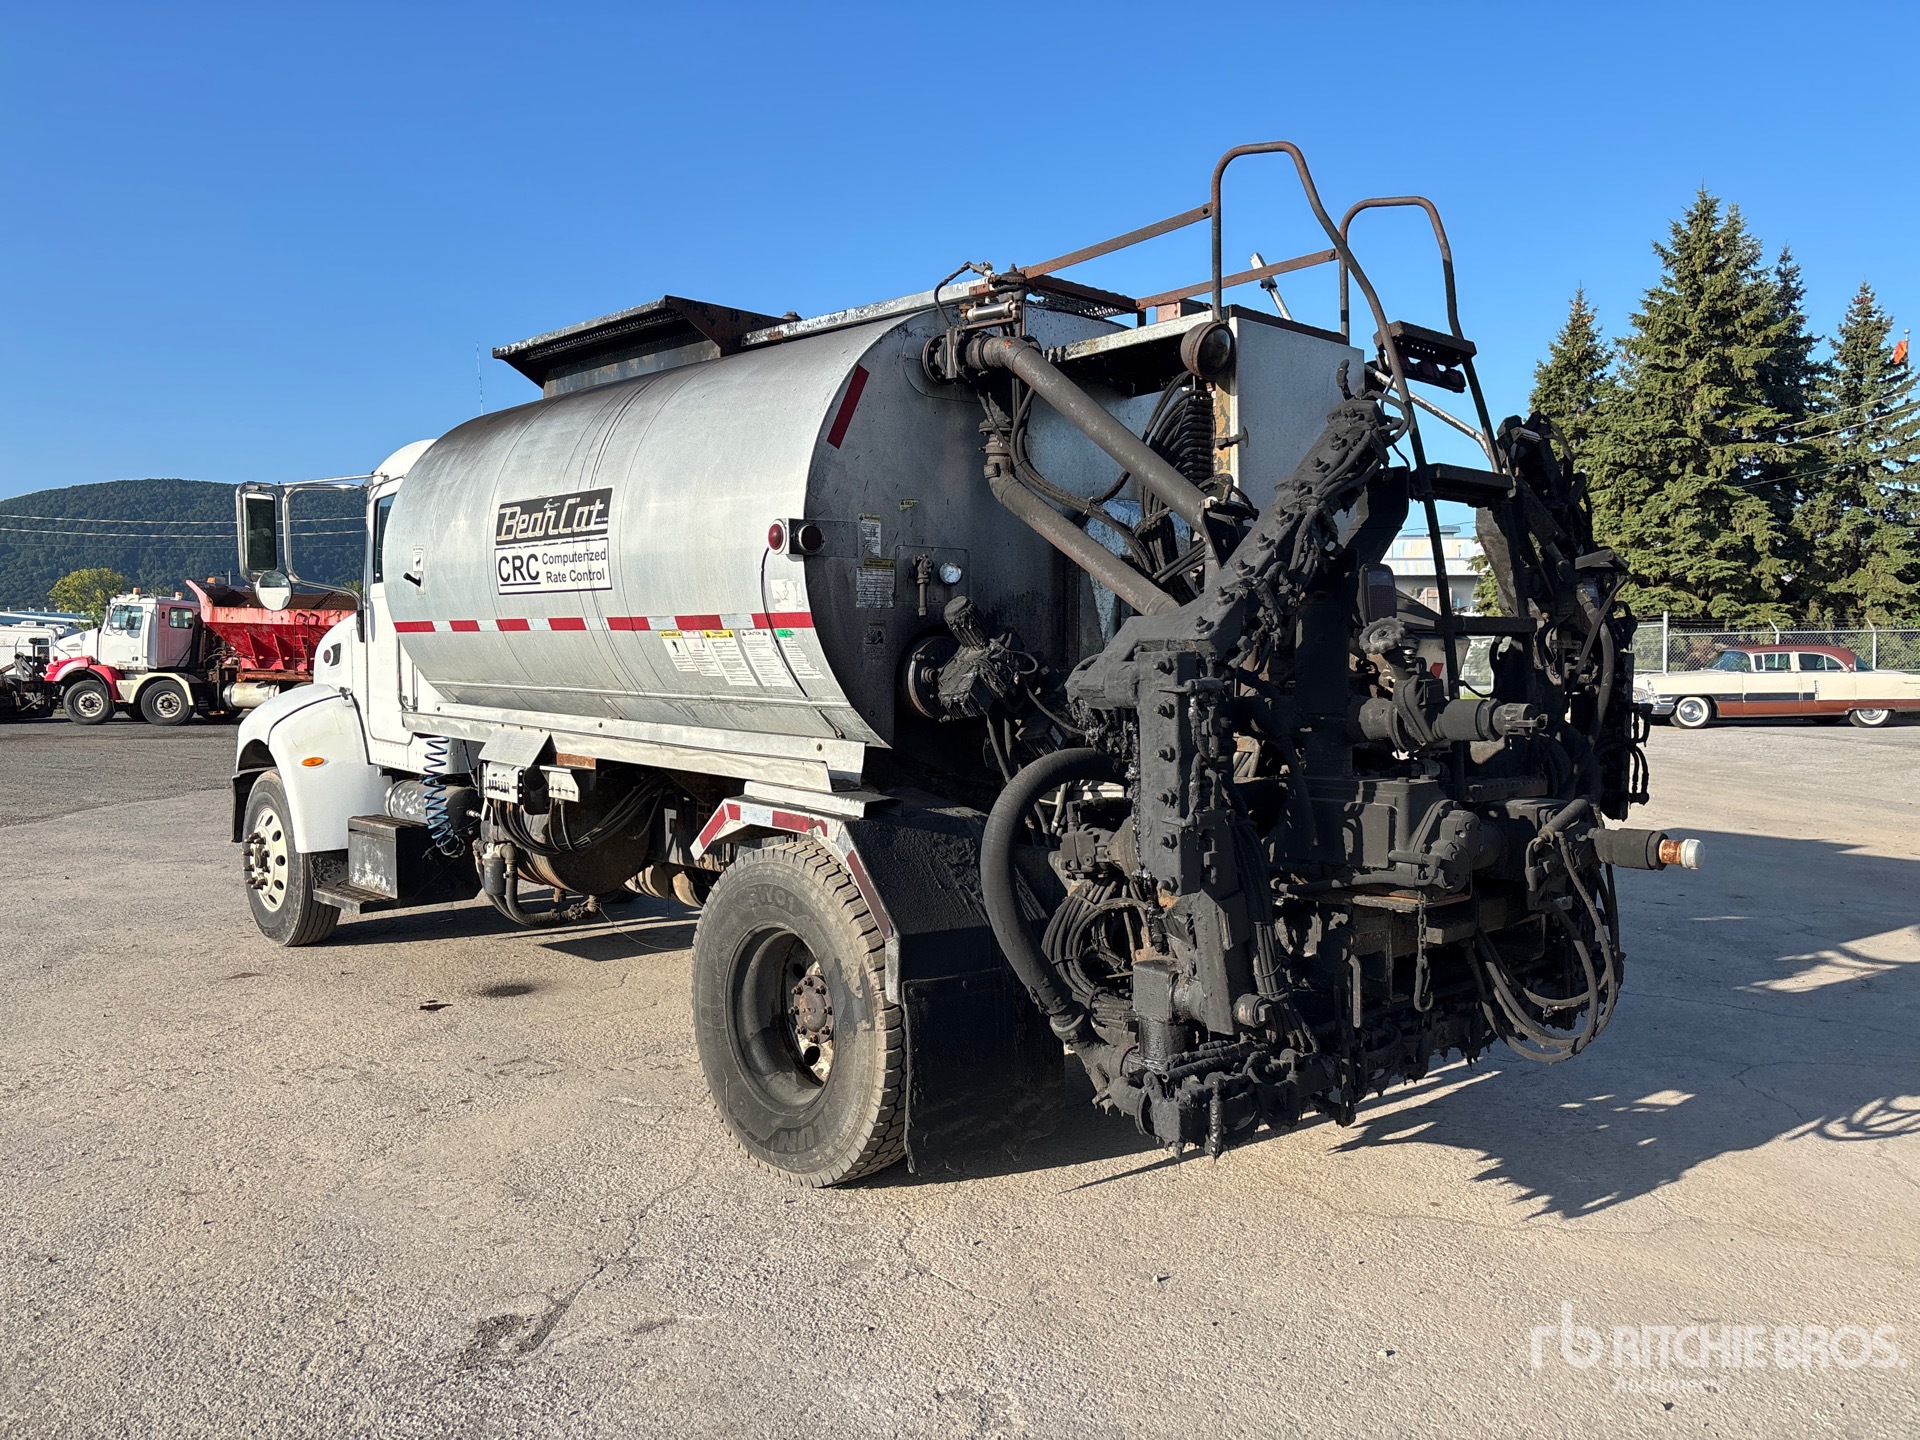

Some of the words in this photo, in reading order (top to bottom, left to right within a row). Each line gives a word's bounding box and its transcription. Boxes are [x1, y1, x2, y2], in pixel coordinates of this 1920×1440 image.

[542, 548, 607, 567] Computerized
[498, 554, 540, 582] CRC
[546, 571, 567, 583] Rate
[569, 568, 605, 582] Control
